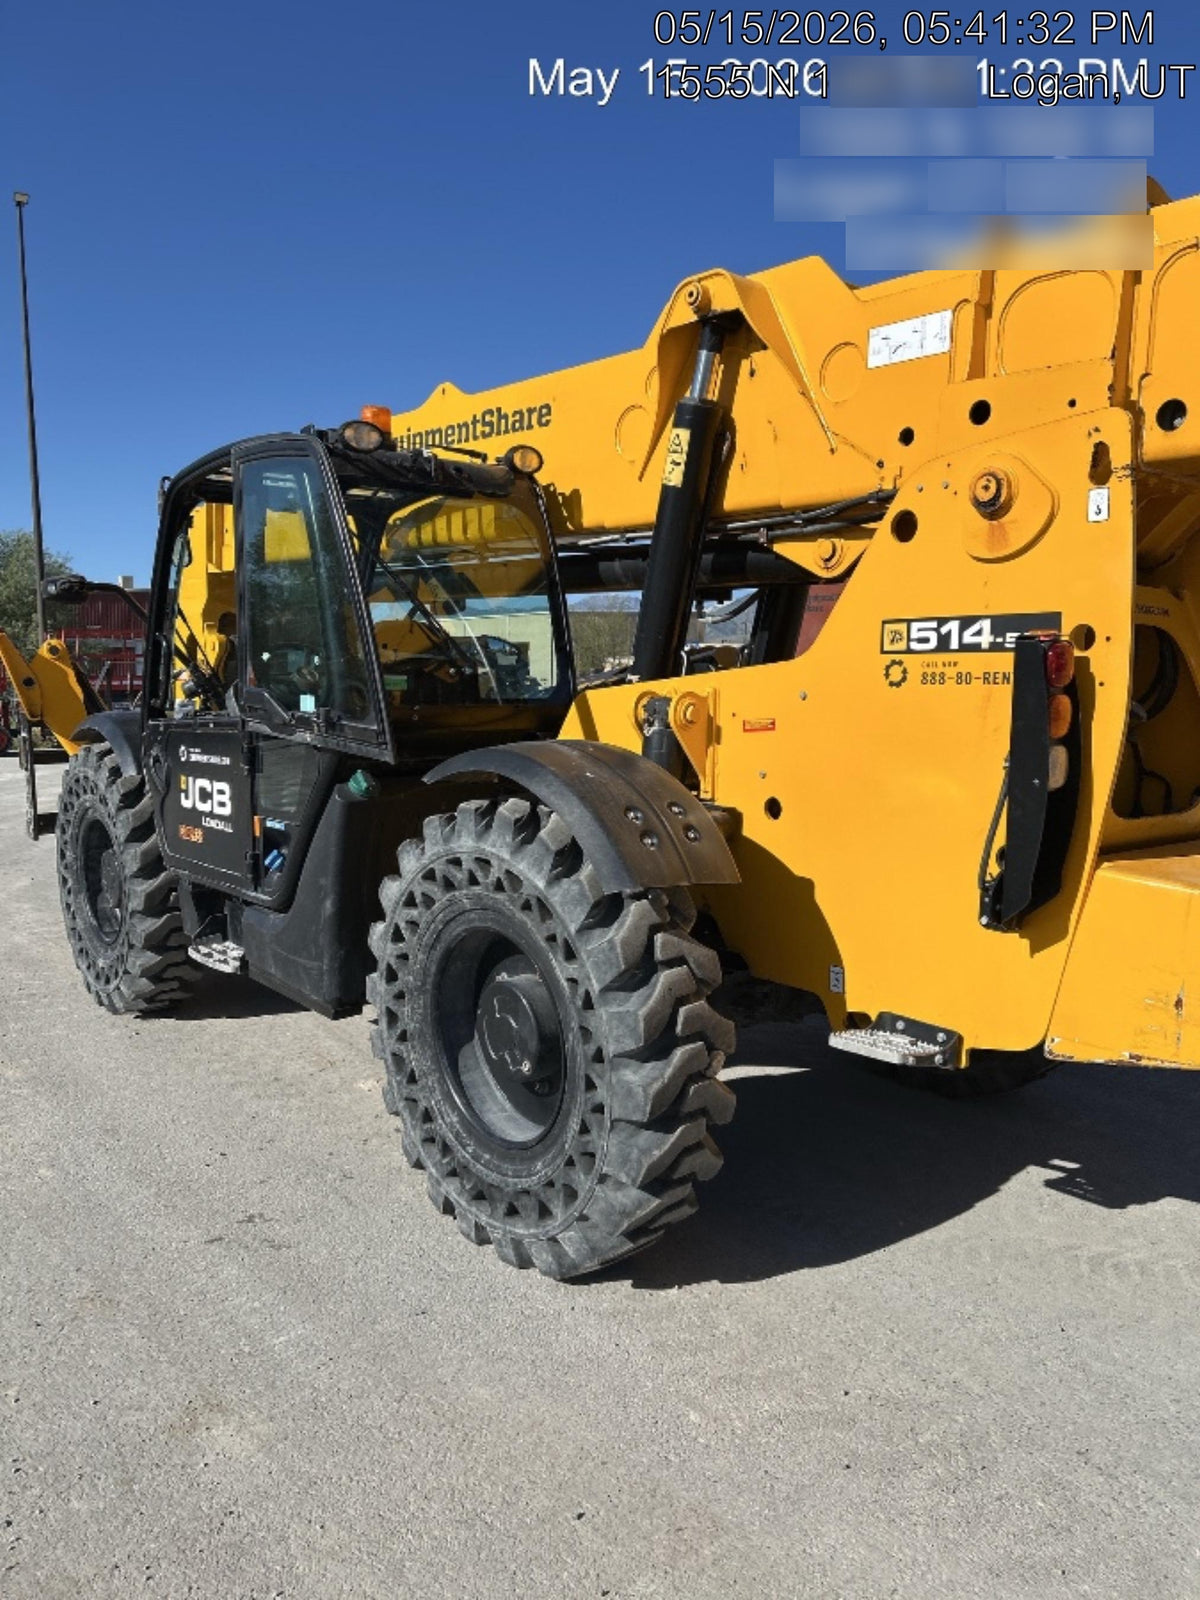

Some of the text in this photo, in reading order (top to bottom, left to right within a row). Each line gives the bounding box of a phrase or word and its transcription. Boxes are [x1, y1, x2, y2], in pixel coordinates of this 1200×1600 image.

[394, 402, 553, 452] uipmentShare
[908, 617, 1024, 652] 514-5
[920, 670, 1014, 686] 888-80-REN
[180, 776, 232, 816] JCB
